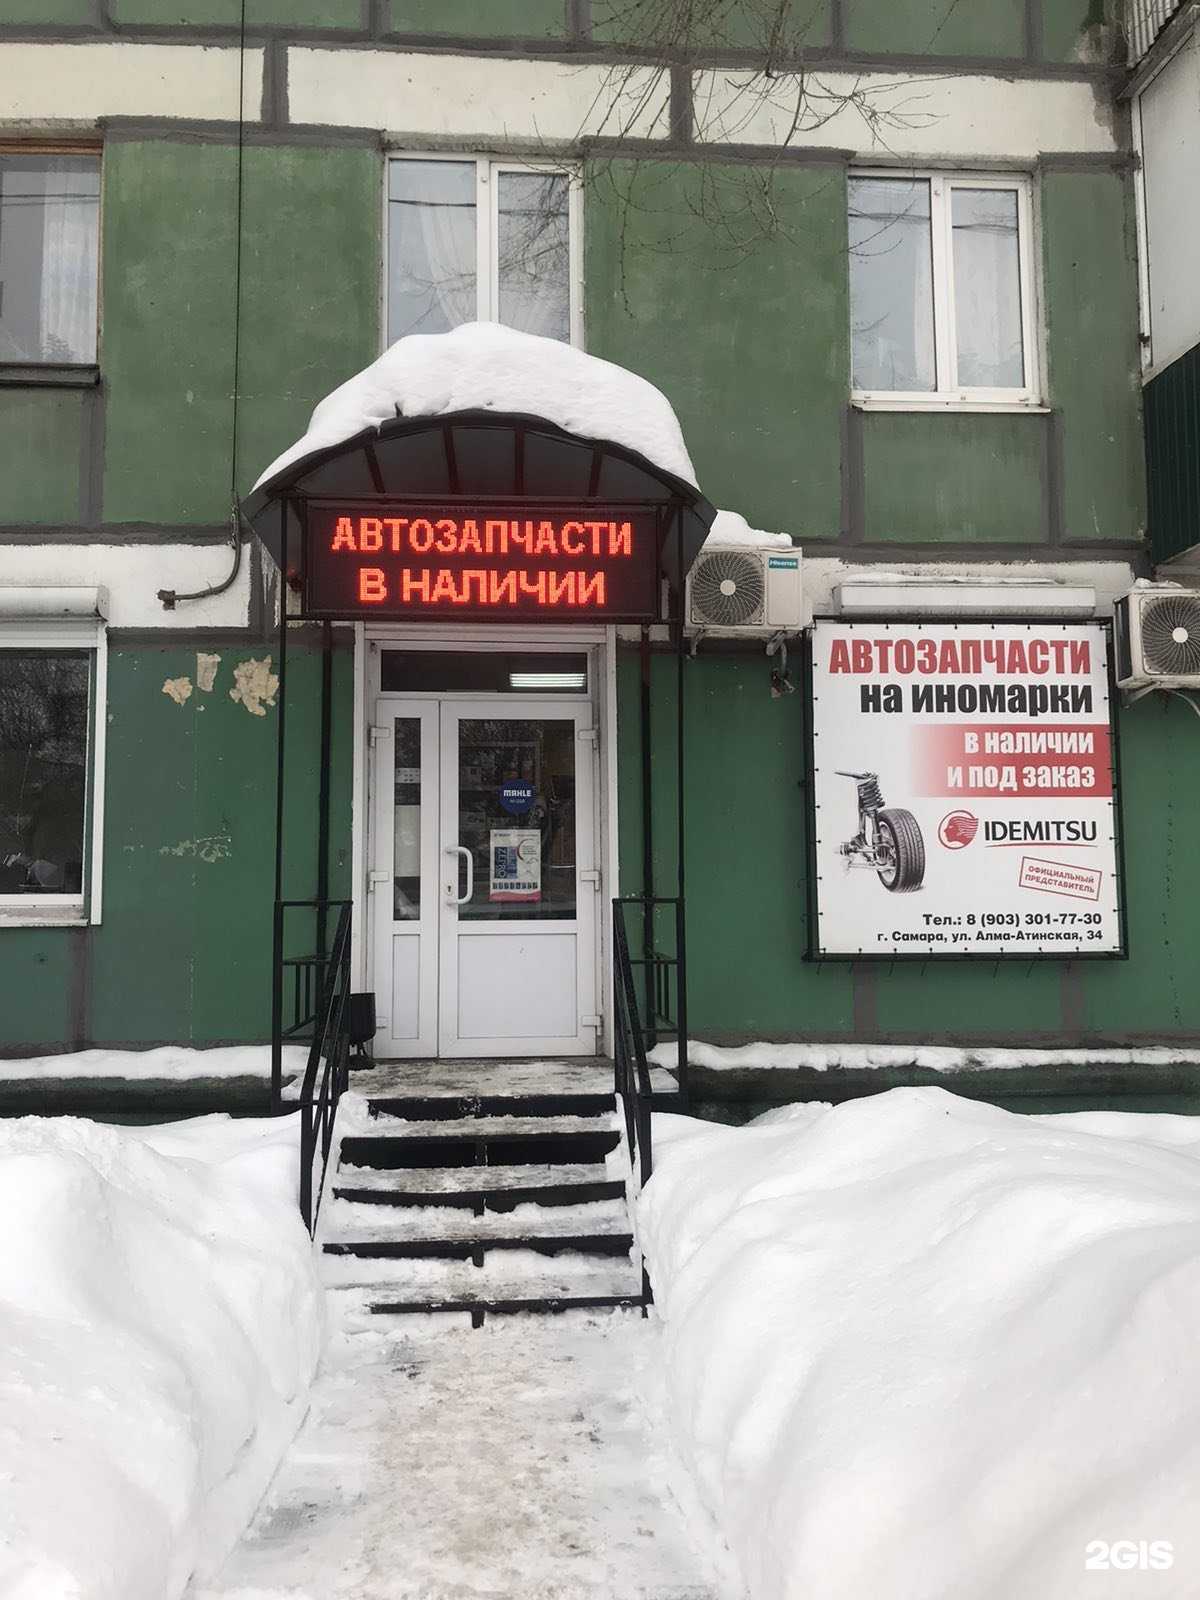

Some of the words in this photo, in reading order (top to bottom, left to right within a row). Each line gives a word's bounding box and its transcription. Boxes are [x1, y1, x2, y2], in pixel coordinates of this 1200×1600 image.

[331, 517, 632, 554] АВТОЗАПЧАСТИ
[360, 568, 387, 601] В
[403, 568, 605, 604] НАЛИЧИИ
[829, 639, 1091, 674] АВТОЗАПЧАСТИ
[860, 683, 903, 713] на
[911, 684, 1093, 716] иномарки
[964, 732, 979, 753] в
[985, 732, 1094, 753] наличии
[948, 766, 963, 788] и
[969, 766, 1018, 791] под
[1023, 766, 1096, 788] заказ
[503, 789, 532, 797] MAHLE
[984, 820, 1097, 841] IDEMITSU
[1025, 874, 1095, 893] ПРЕДСТАВИТЕЛЬ
[1028, 865, 1094, 884] ОФИЦИАЛЬНЫЙ
[923, 914, 962, 926] Тел.:
[966, 914, 976, 925] 8
[981, 913, 1020, 927] (903)
[1025, 913, 1102, 925] 301-77-30
[877, 933, 888, 941] г.
[892, 931, 948, 943] Самара,
[952, 932, 971, 943] ул.
[976, 930, 1083, 942] Алма-Атинская,
[1087, 930, 1103, 940] 34
